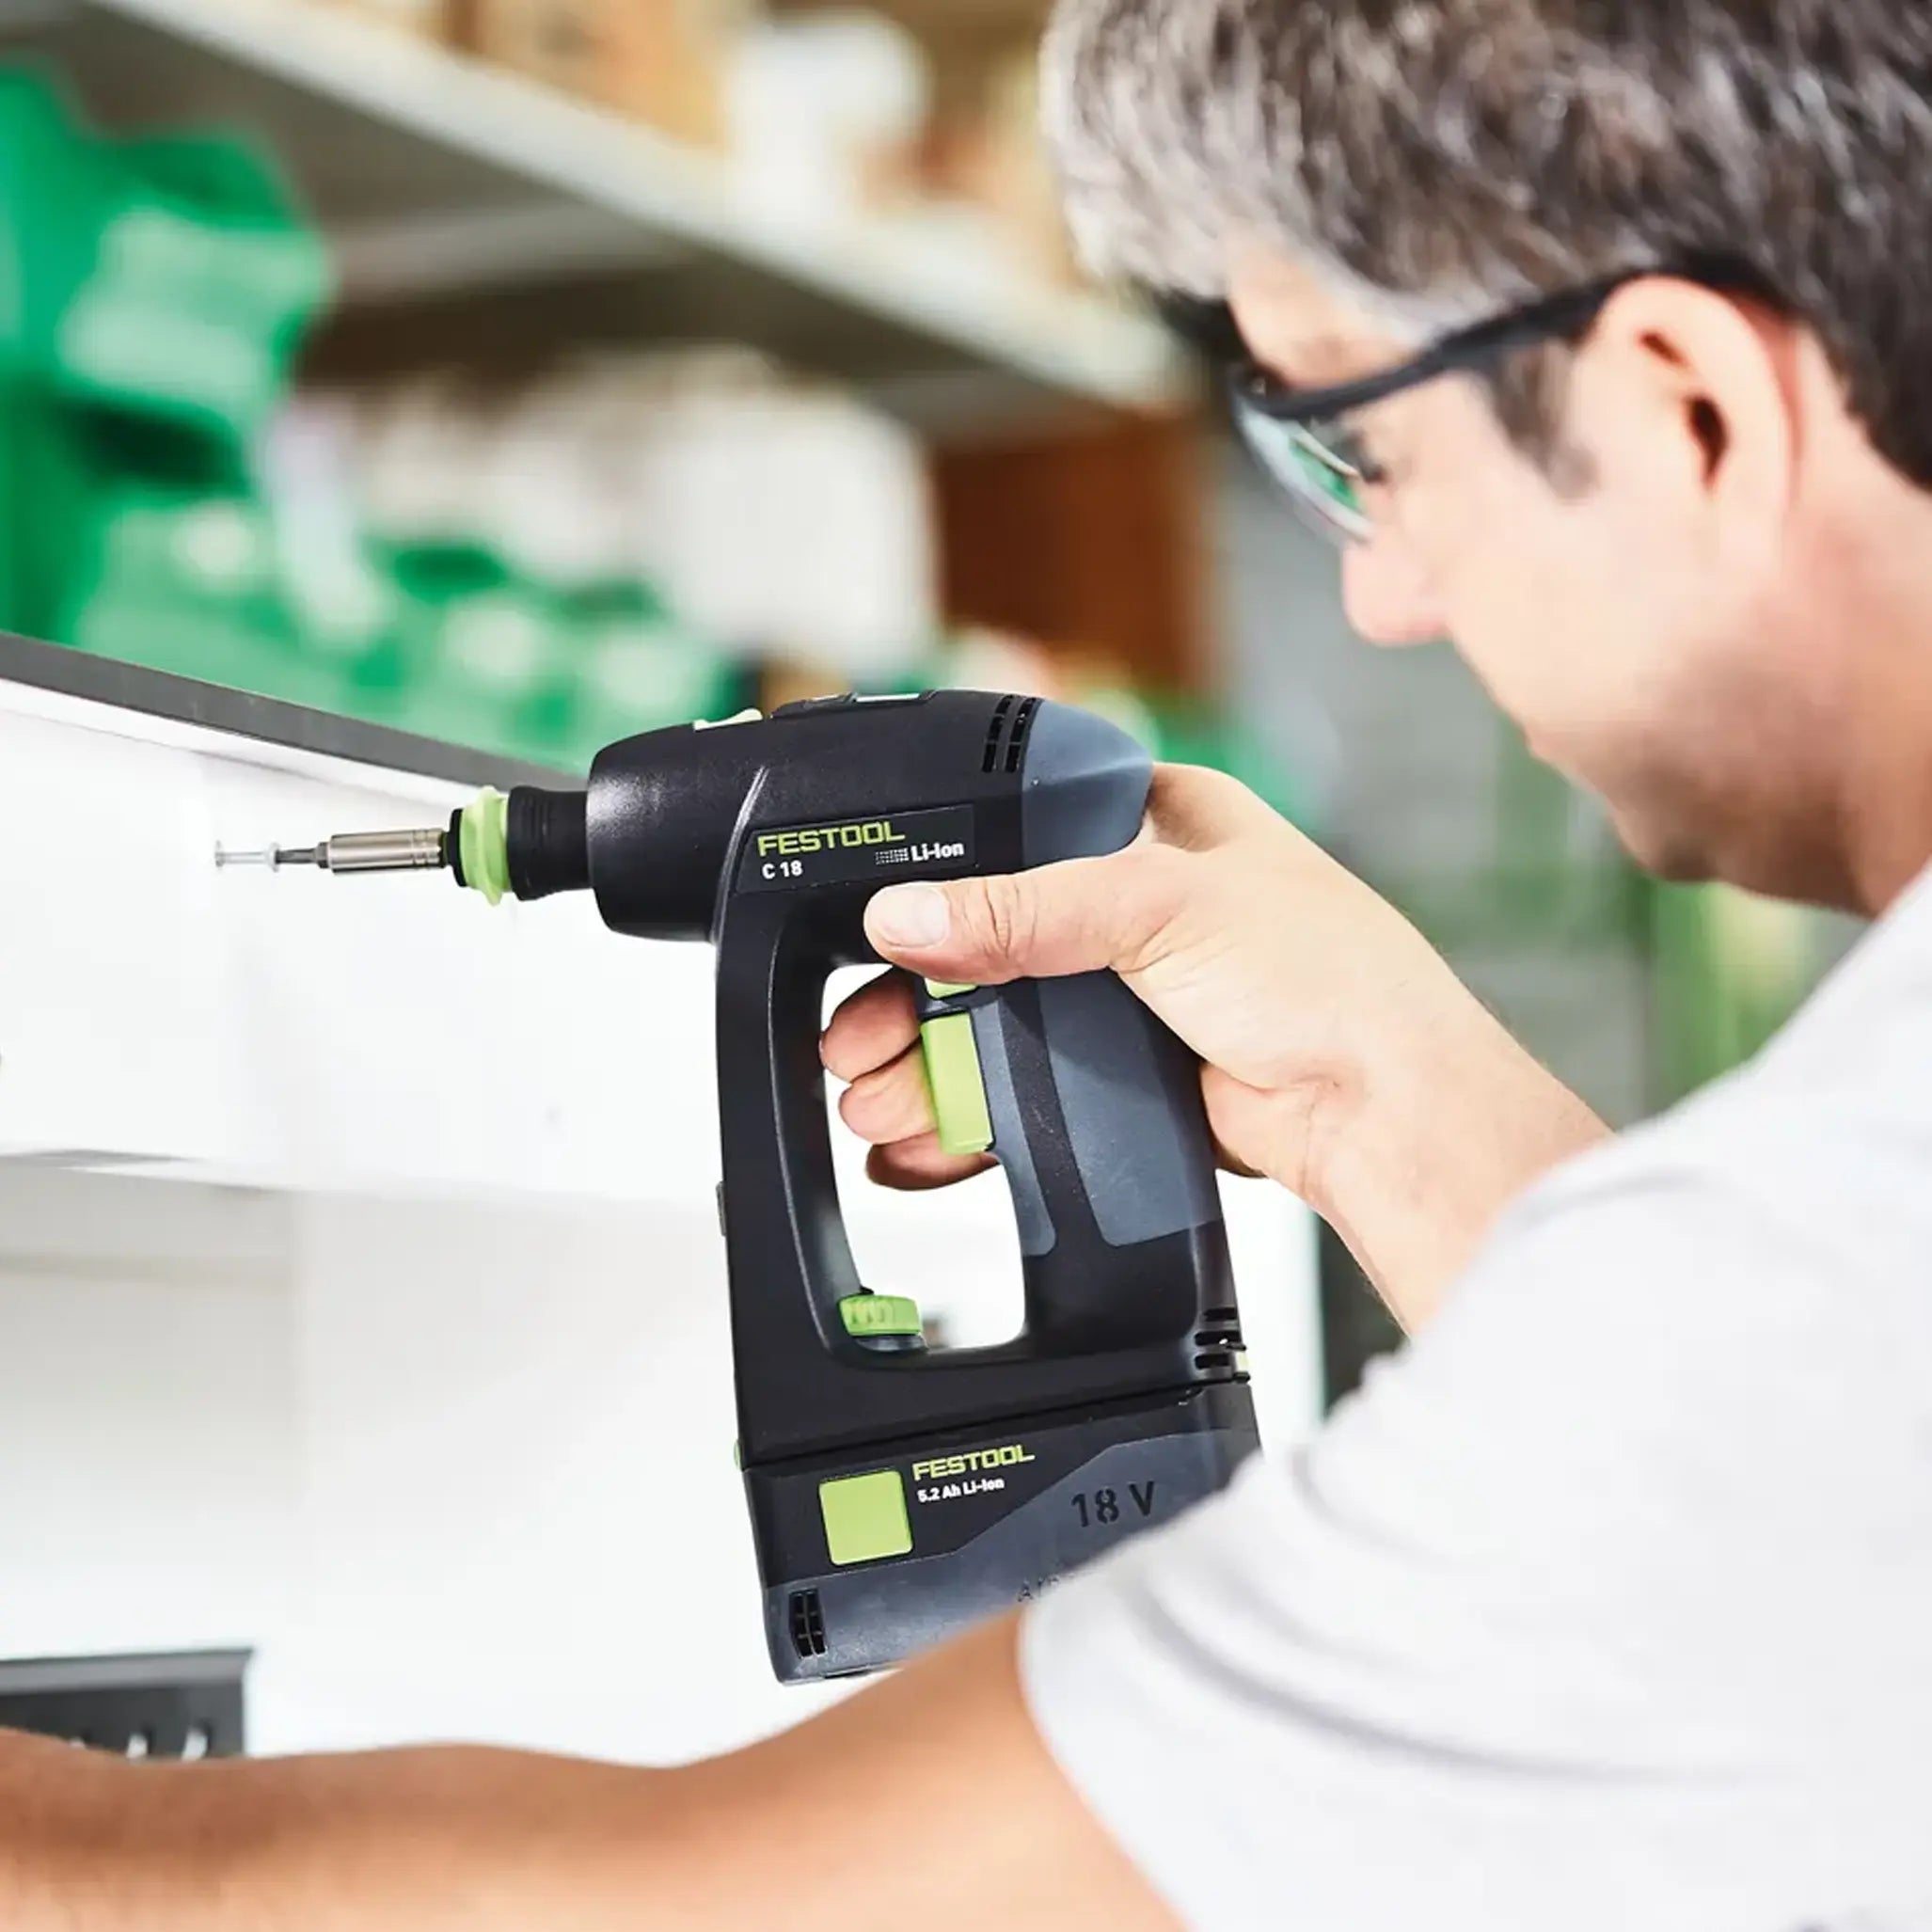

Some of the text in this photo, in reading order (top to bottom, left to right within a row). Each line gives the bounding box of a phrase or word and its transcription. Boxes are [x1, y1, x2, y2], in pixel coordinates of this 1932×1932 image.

[757, 821, 906, 857] FESTOOL
[911, 842, 965, 863] Li-Ion
[762, 860, 803, 879] C 18
[912, 1444, 1036, 1481] FESTOOL
[917, 1487, 940, 1503] 5.2
[942, 1483, 961, 1499] Ah
[1070, 1481, 1155, 1528] 18 V
